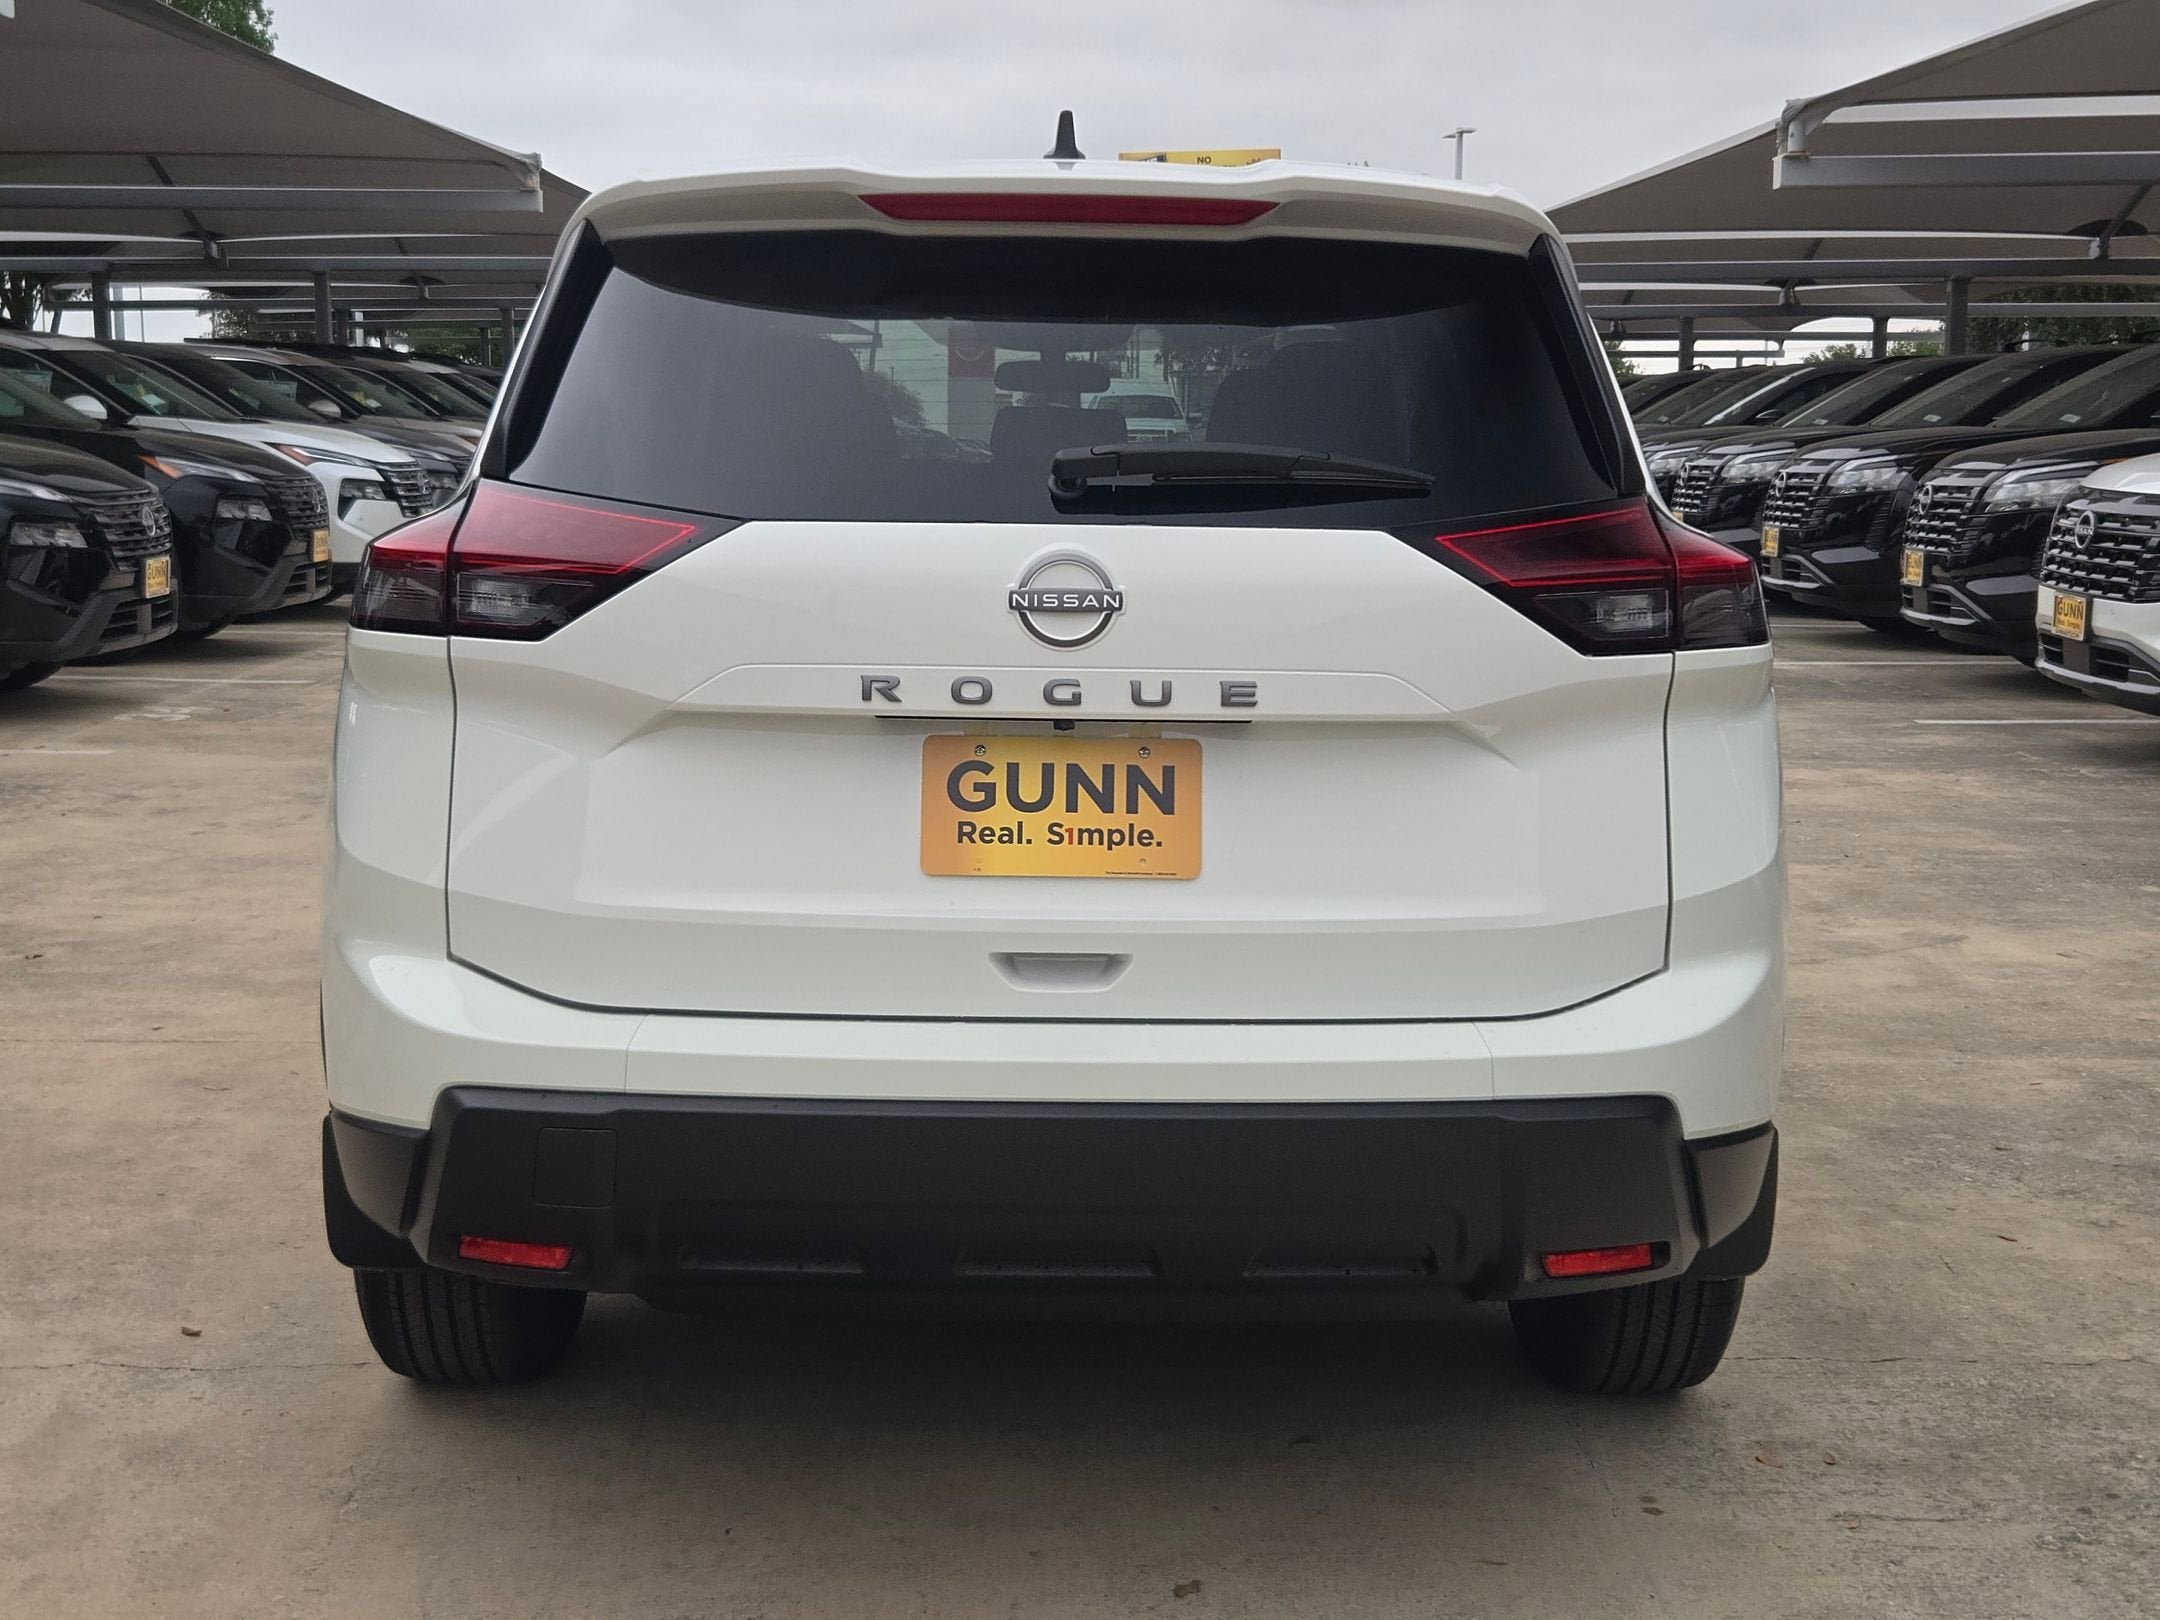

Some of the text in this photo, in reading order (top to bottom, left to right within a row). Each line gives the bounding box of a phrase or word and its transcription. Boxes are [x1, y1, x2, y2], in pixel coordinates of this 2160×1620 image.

[1197, 156, 1212, 165] NO
[1012, 593, 1120, 608] NISSAN
[2057, 600, 2084, 620] GUNN
[860, 675, 1258, 708] ROGUE
[946, 759, 1176, 816] GUNN
[957, 820, 1033, 845] Real.
